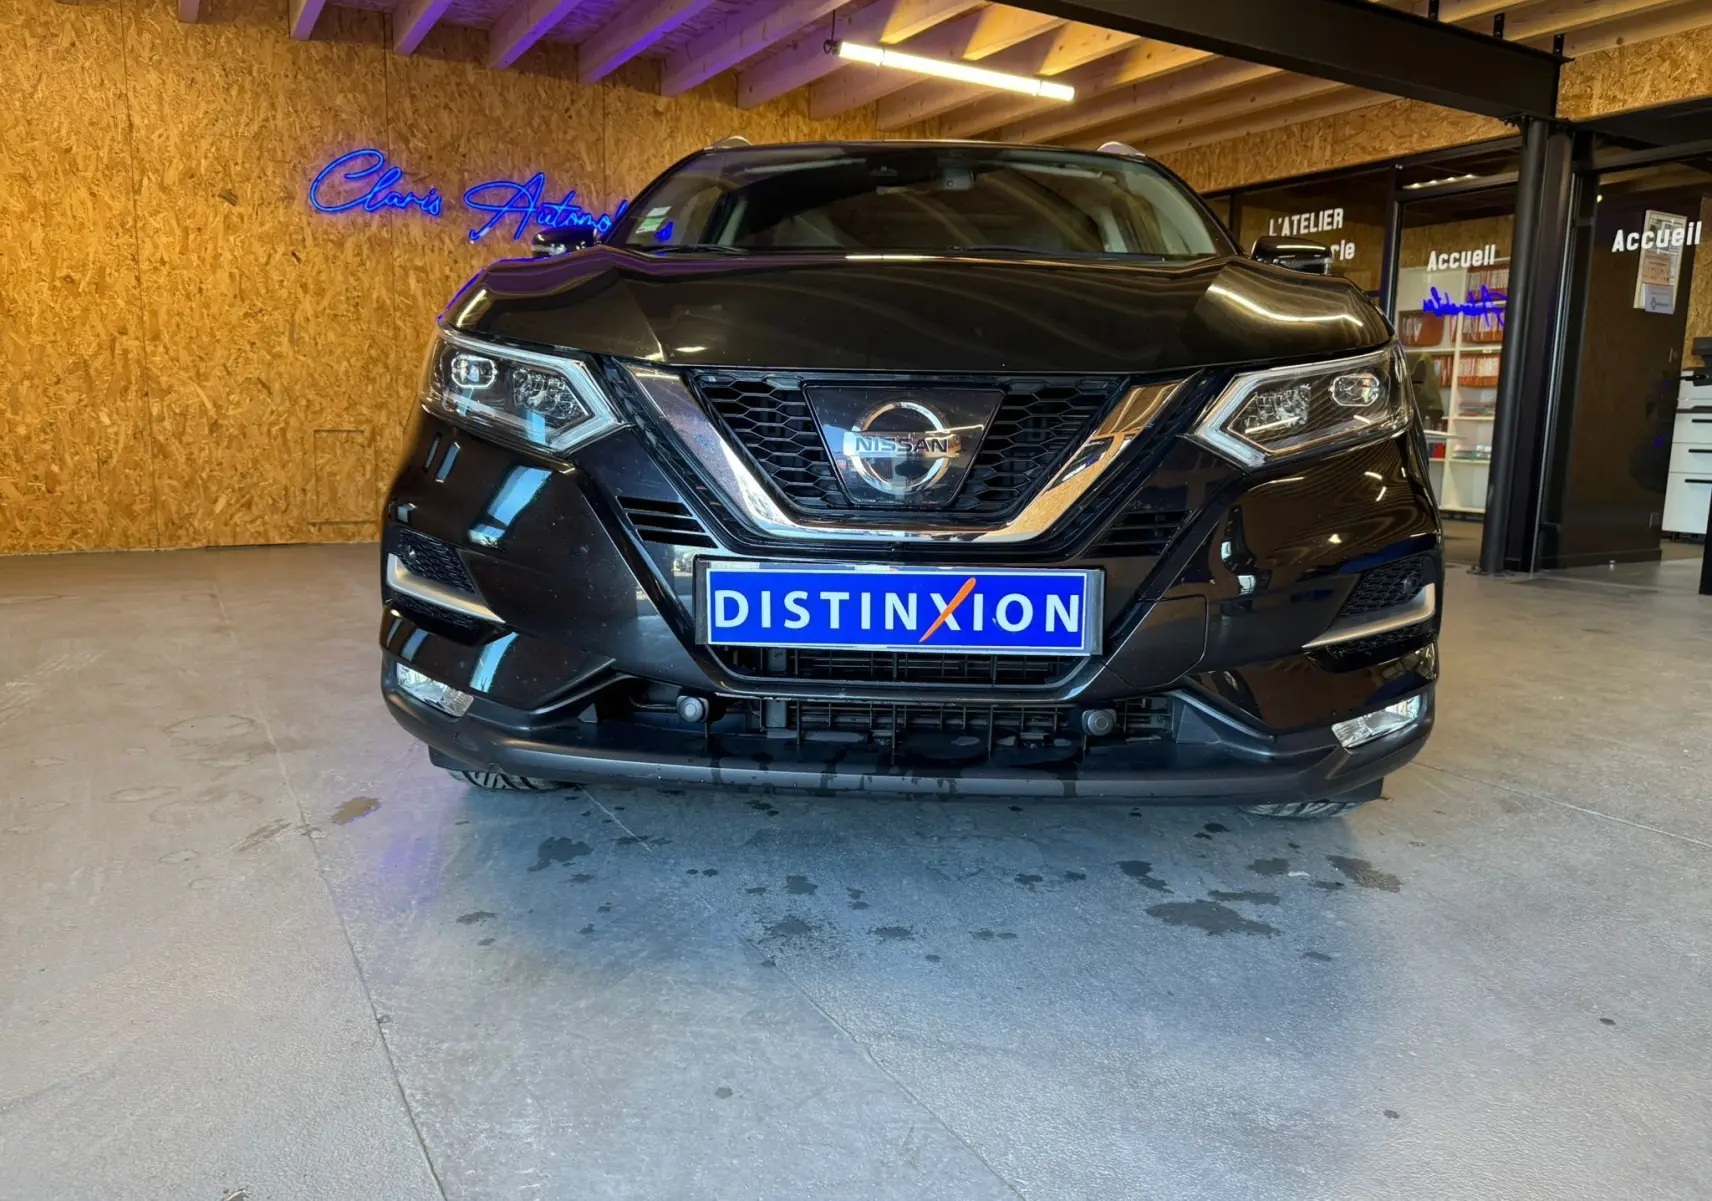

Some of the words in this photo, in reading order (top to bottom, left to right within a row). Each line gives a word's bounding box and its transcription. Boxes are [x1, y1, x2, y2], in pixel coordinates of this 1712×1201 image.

[1268, 207, 1344, 237] L'ATELIER
[1611, 220, 1702, 253] Accueil
[1426, 243, 1497, 272] Accueil
[855, 436, 949, 454] NISSAN
[713, 577, 1080, 644] DISTINXION
